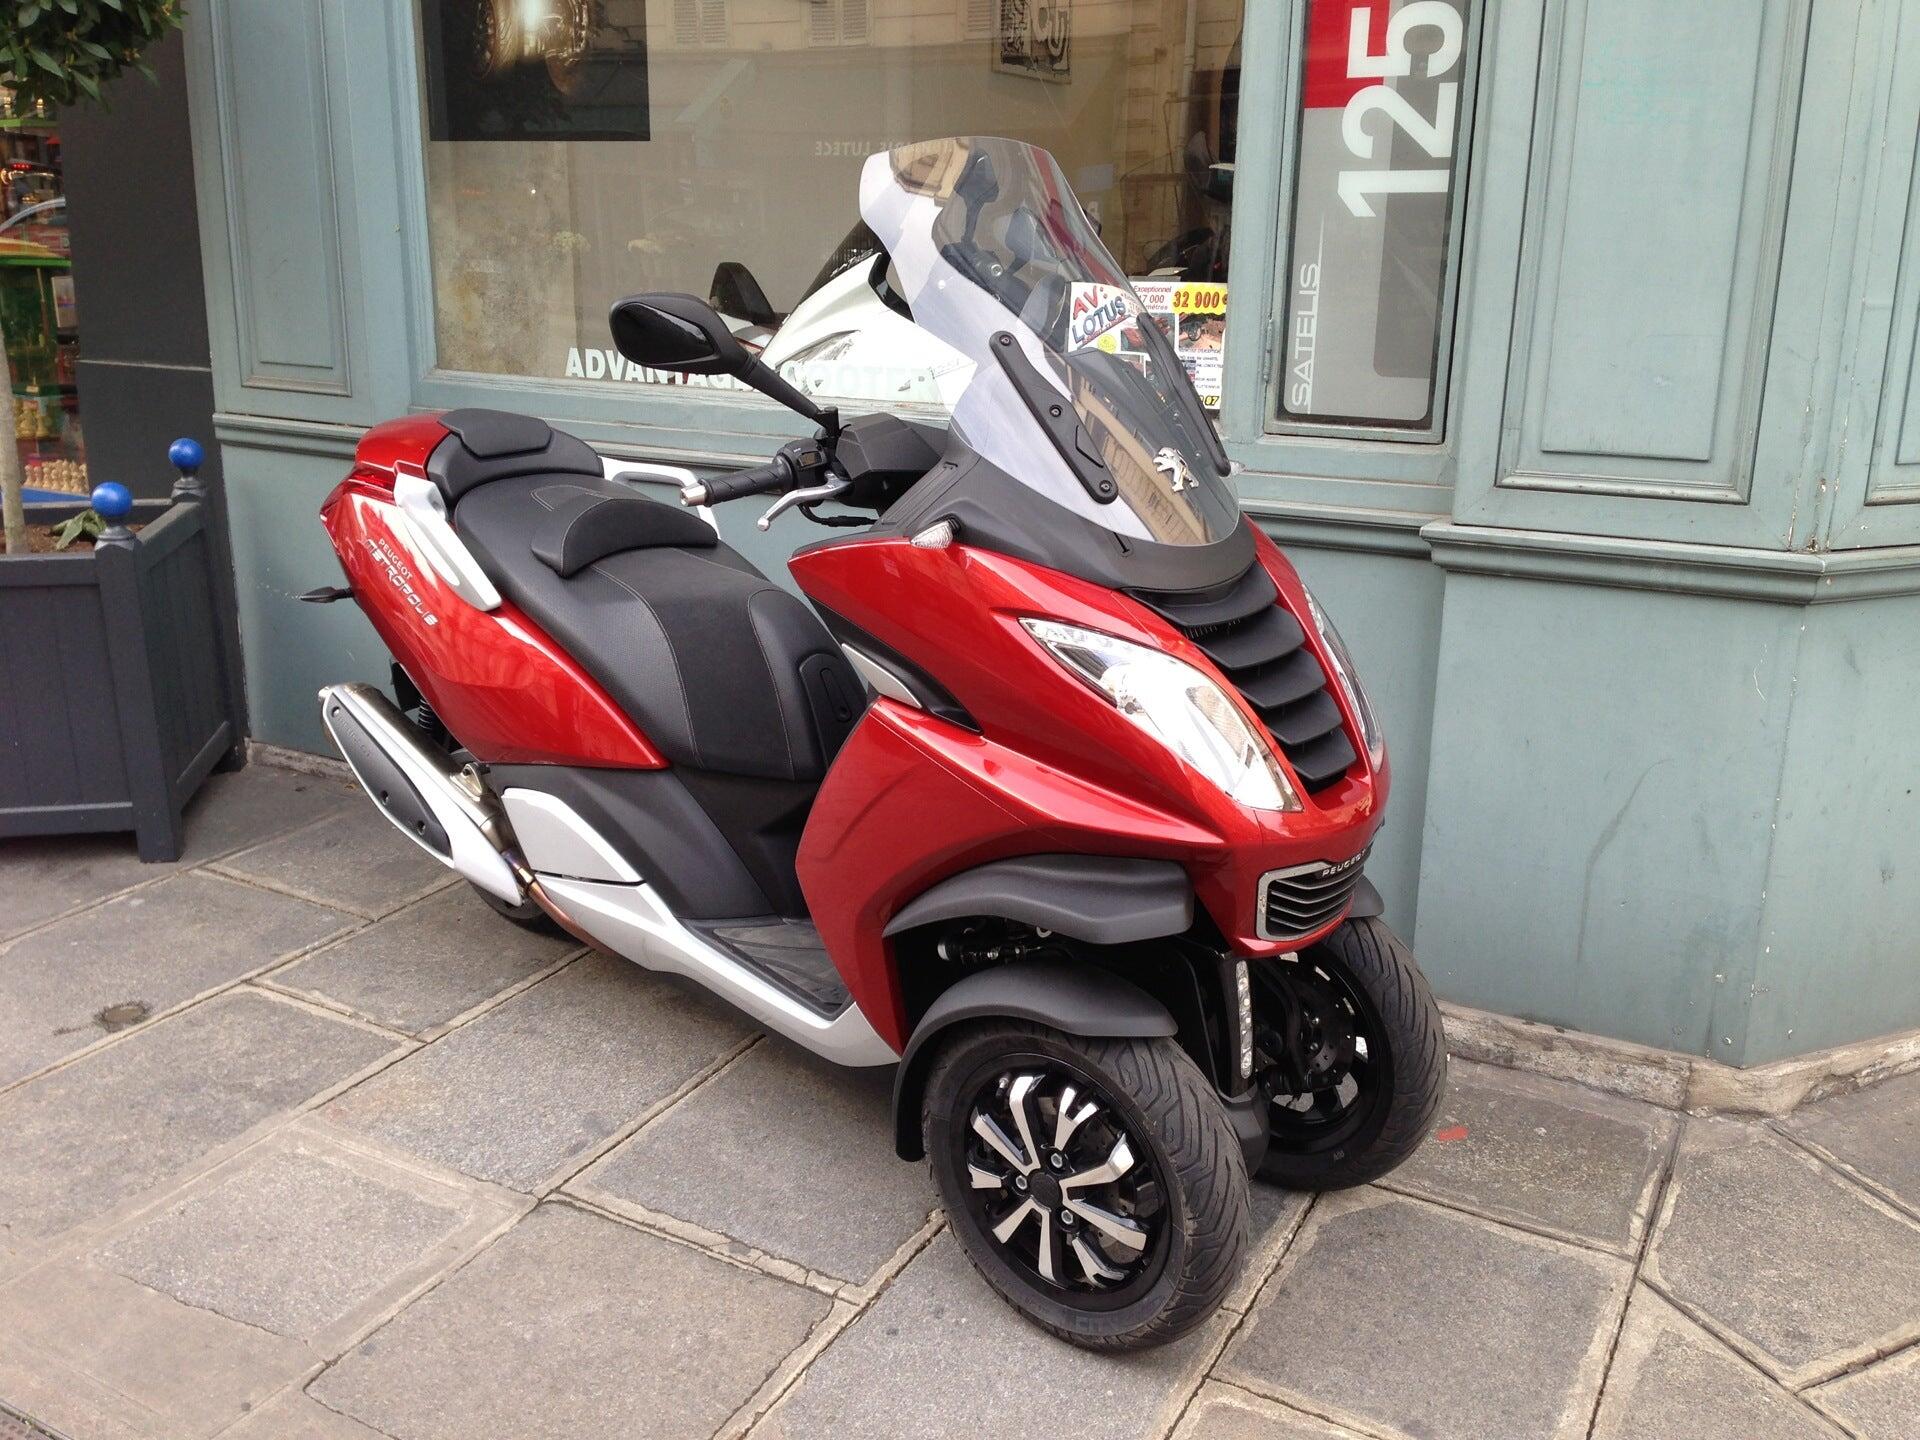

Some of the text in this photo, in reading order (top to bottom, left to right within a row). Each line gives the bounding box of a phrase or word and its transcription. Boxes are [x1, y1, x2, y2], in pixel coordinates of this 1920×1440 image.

[1337, 0, 1463, 218] 125
[1072, 295, 1128, 344] LOTUS
[1172, 290, 1189, 308] 32
[1291, 262, 1319, 407] SATELIS
[565, 347, 752, 391] ADVANAG
[365, 538, 438, 626] METROPOLIS
[379, 538, 412, 580] PEUGEOT
[1322, 849, 1366, 877] PEUGEOT
